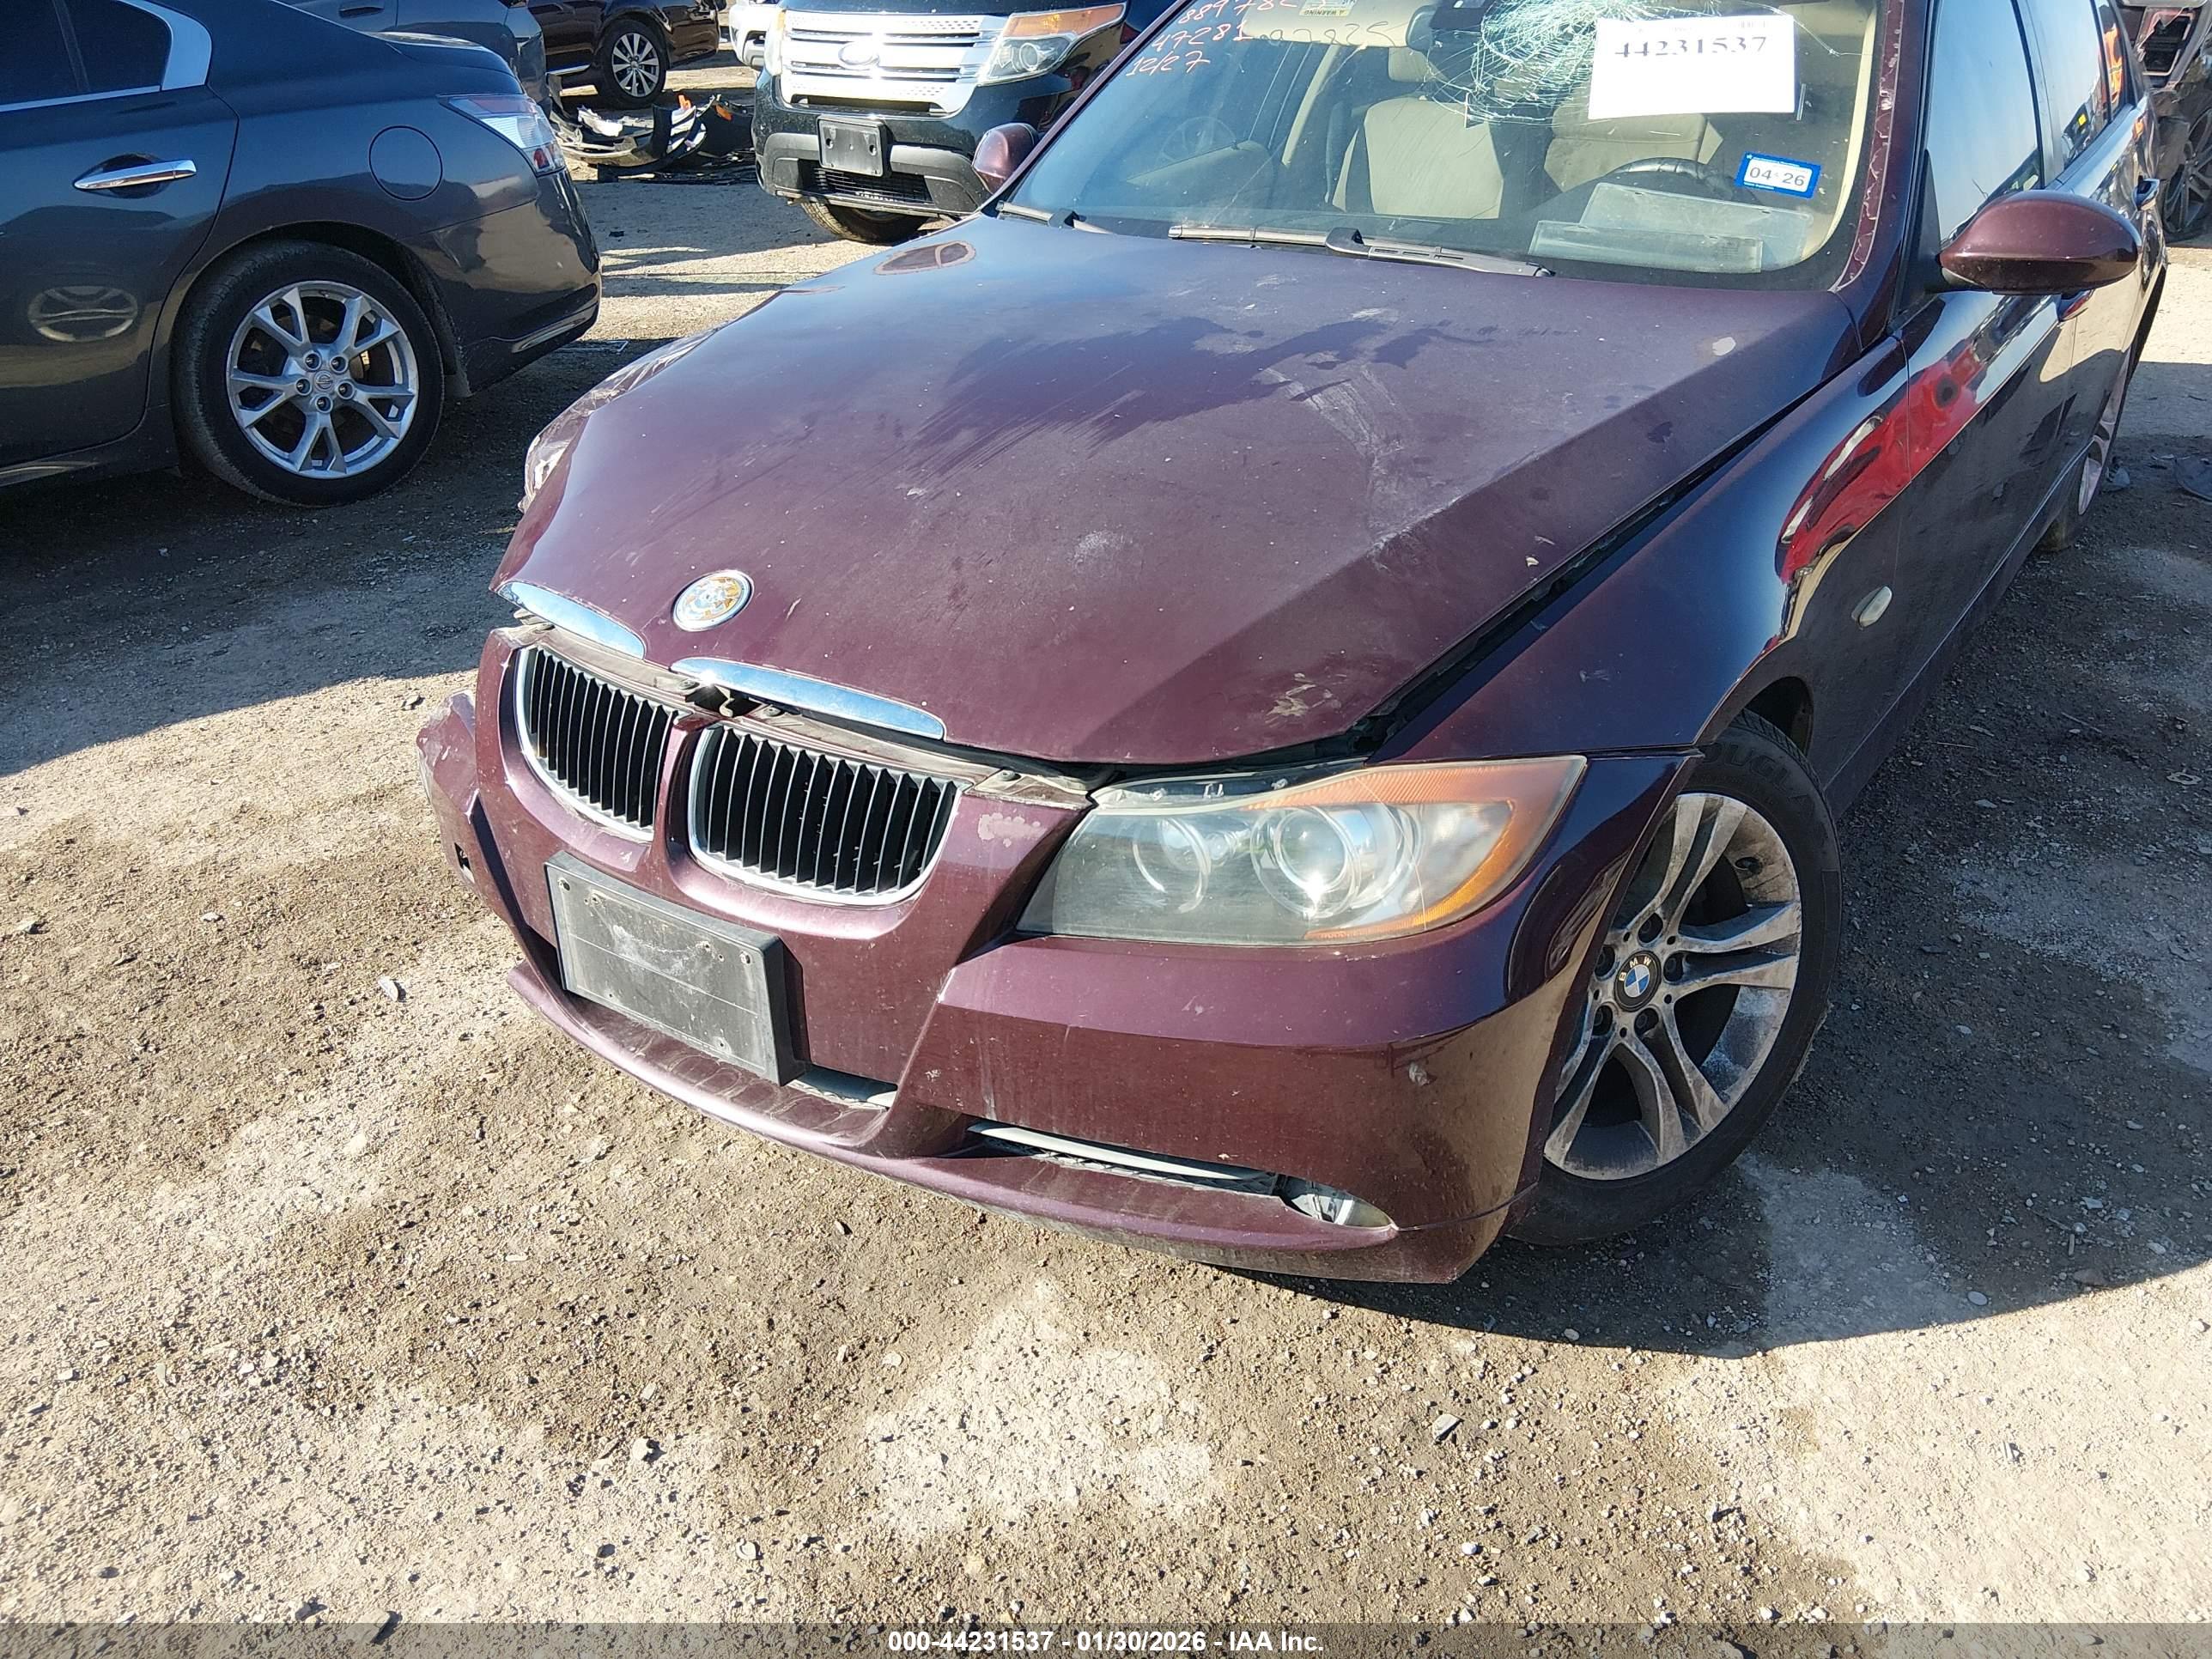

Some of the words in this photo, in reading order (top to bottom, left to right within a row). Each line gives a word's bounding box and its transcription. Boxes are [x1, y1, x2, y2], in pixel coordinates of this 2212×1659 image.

[1615, 36, 1767, 58] 44231537
[1749, 167, 1772, 180] 04
[1782, 173, 1806, 186] 26
[1619, 956, 1652, 981] BMW
